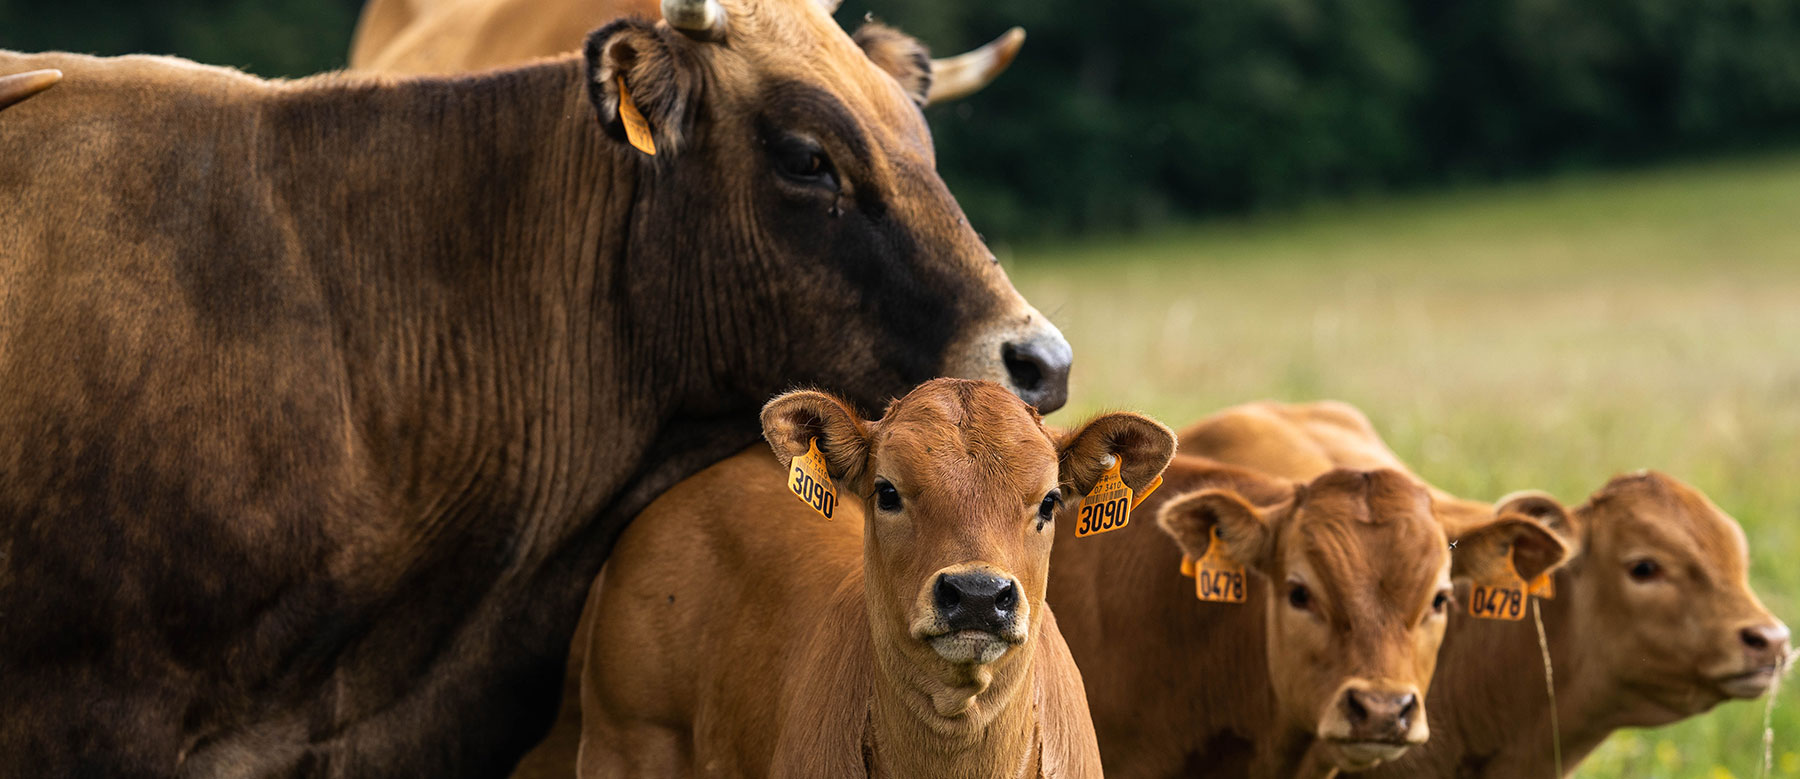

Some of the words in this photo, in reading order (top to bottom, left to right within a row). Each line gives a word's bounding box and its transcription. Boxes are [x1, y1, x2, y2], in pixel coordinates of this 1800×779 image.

[793, 466, 834, 519] 3090
[1094, 485, 1103, 494] 07
[1105, 481, 1122, 492] 3410
[1079, 498, 1128, 535] 3090
[1201, 570, 1242, 600] 0478
[1473, 586, 1521, 616] 0478
